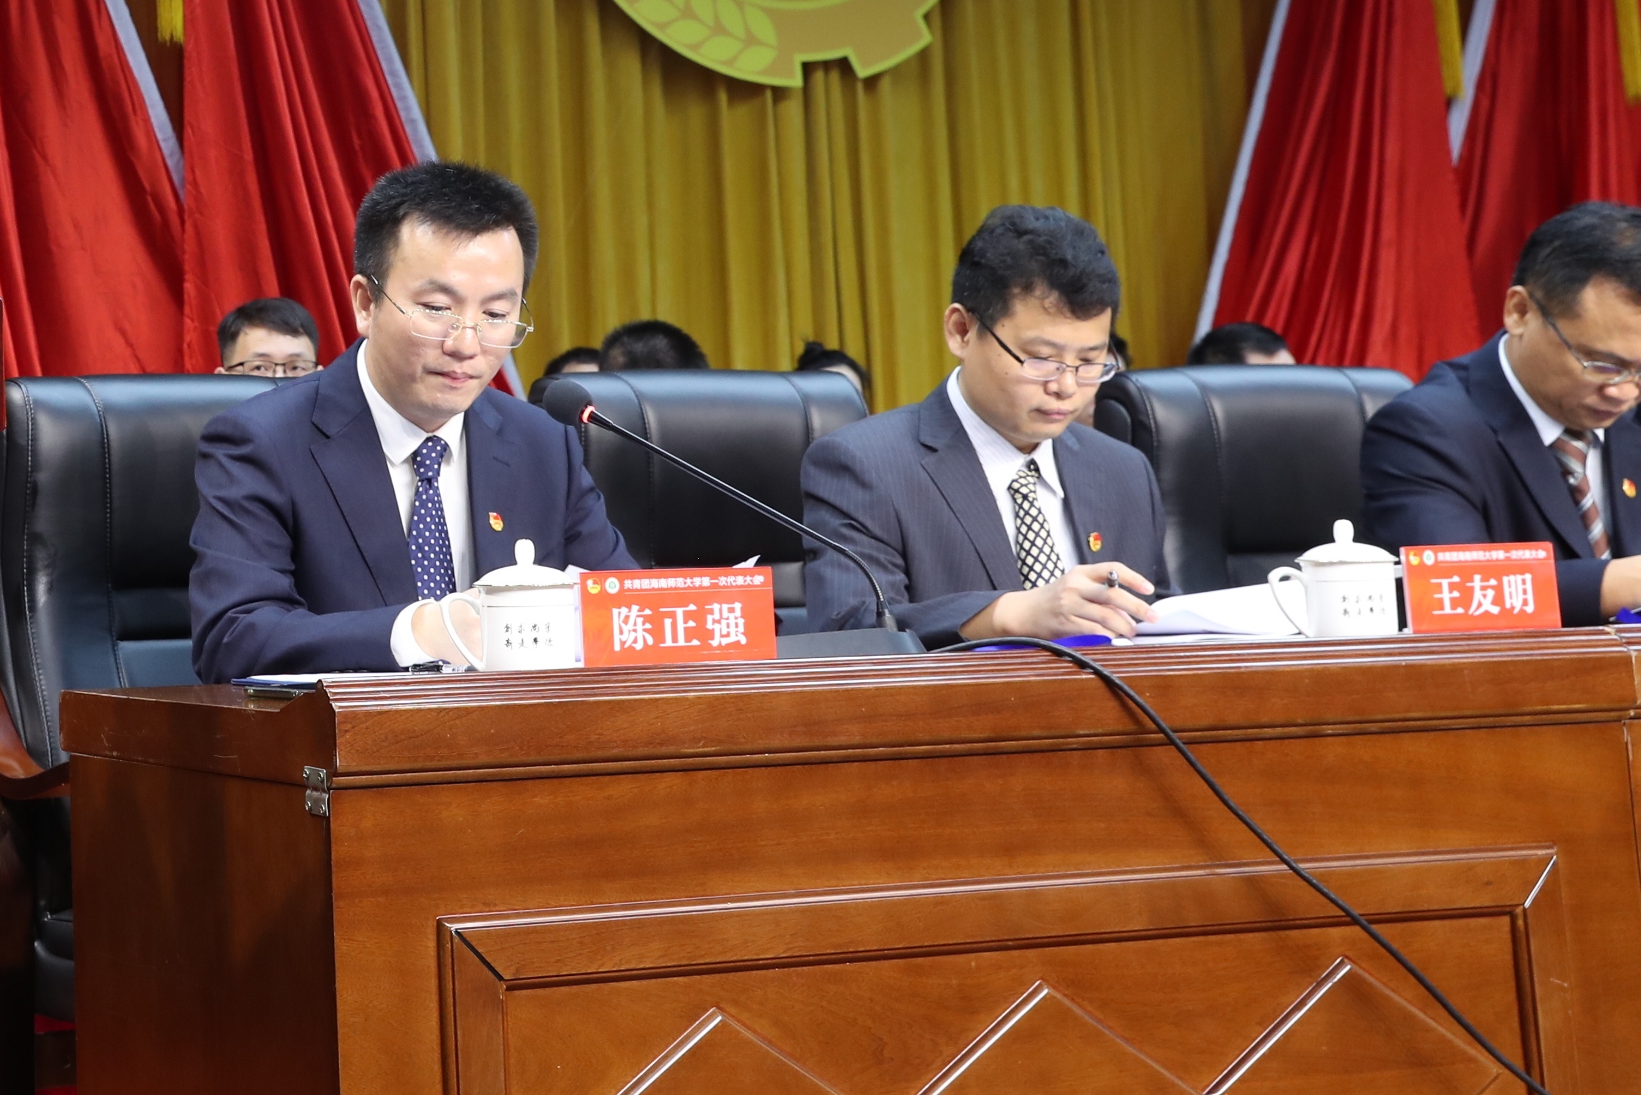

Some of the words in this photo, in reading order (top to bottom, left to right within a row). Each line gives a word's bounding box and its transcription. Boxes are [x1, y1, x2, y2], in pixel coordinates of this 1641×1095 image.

[1429, 572, 1536, 617] 王友明
[611, 601, 748, 652] 陈正强
